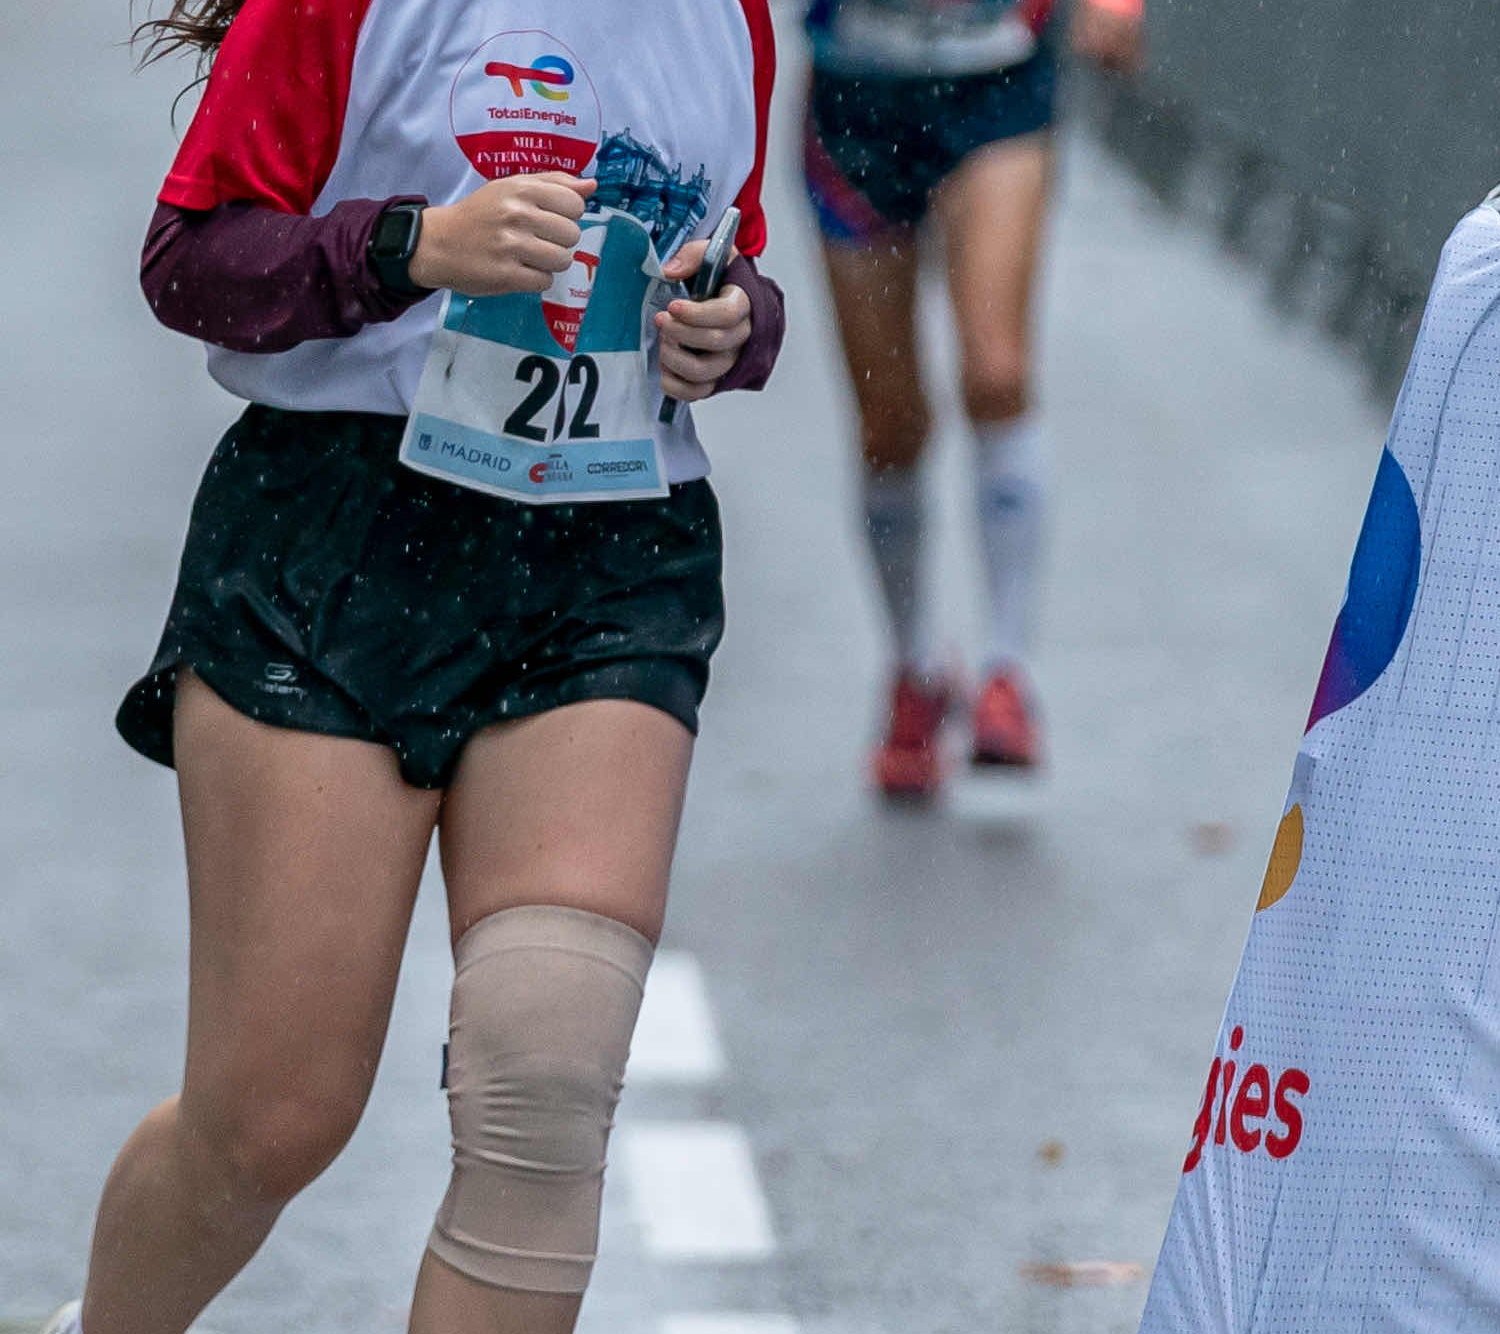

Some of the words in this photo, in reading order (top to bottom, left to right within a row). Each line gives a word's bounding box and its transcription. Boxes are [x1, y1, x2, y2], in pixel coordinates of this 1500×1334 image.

[487, 107, 577, 126] TotalEnergies
[512, 136, 553, 151] MILLA
[440, 441, 512, 473] MADRID
